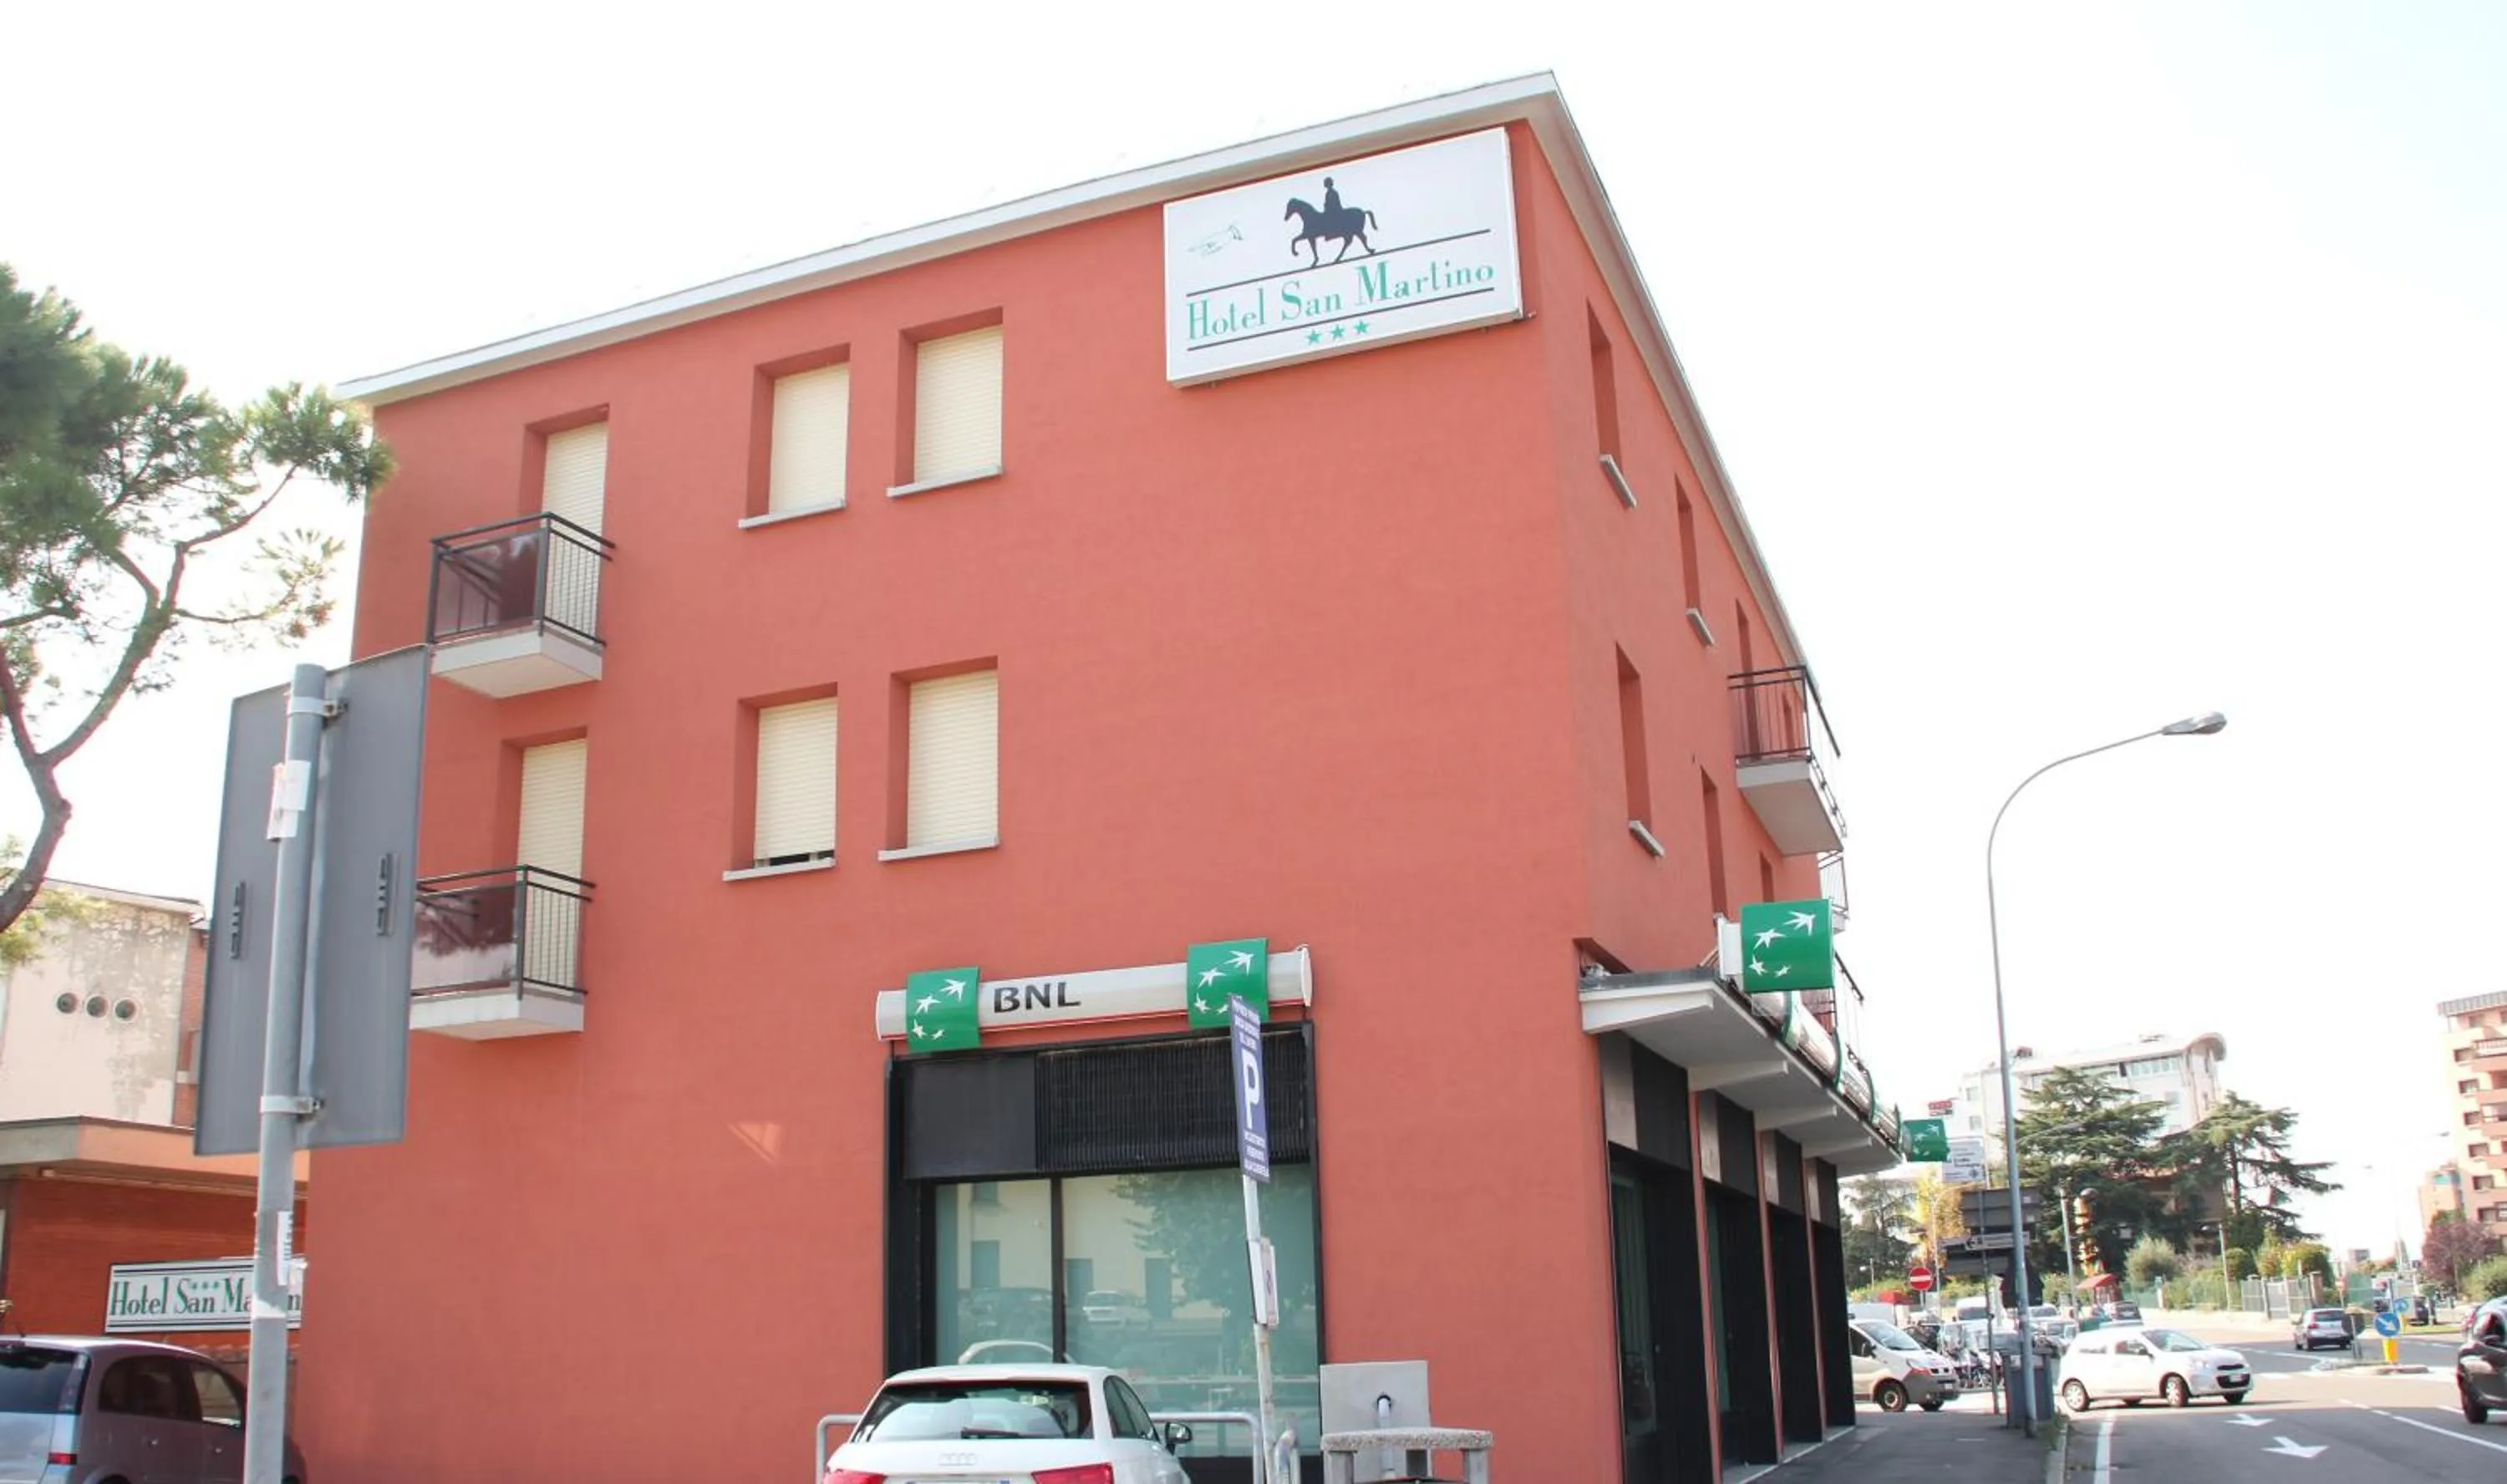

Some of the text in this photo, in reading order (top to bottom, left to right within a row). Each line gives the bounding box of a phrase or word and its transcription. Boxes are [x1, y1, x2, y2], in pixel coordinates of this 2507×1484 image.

[1187, 260, 1494, 340] Hotel San Martino
[994, 982, 1081, 1013] BNL
[1241, 1048, 1260, 1129] P
[109, 1277, 170, 1315] Hotel
[173, 1278, 215, 1314] San
